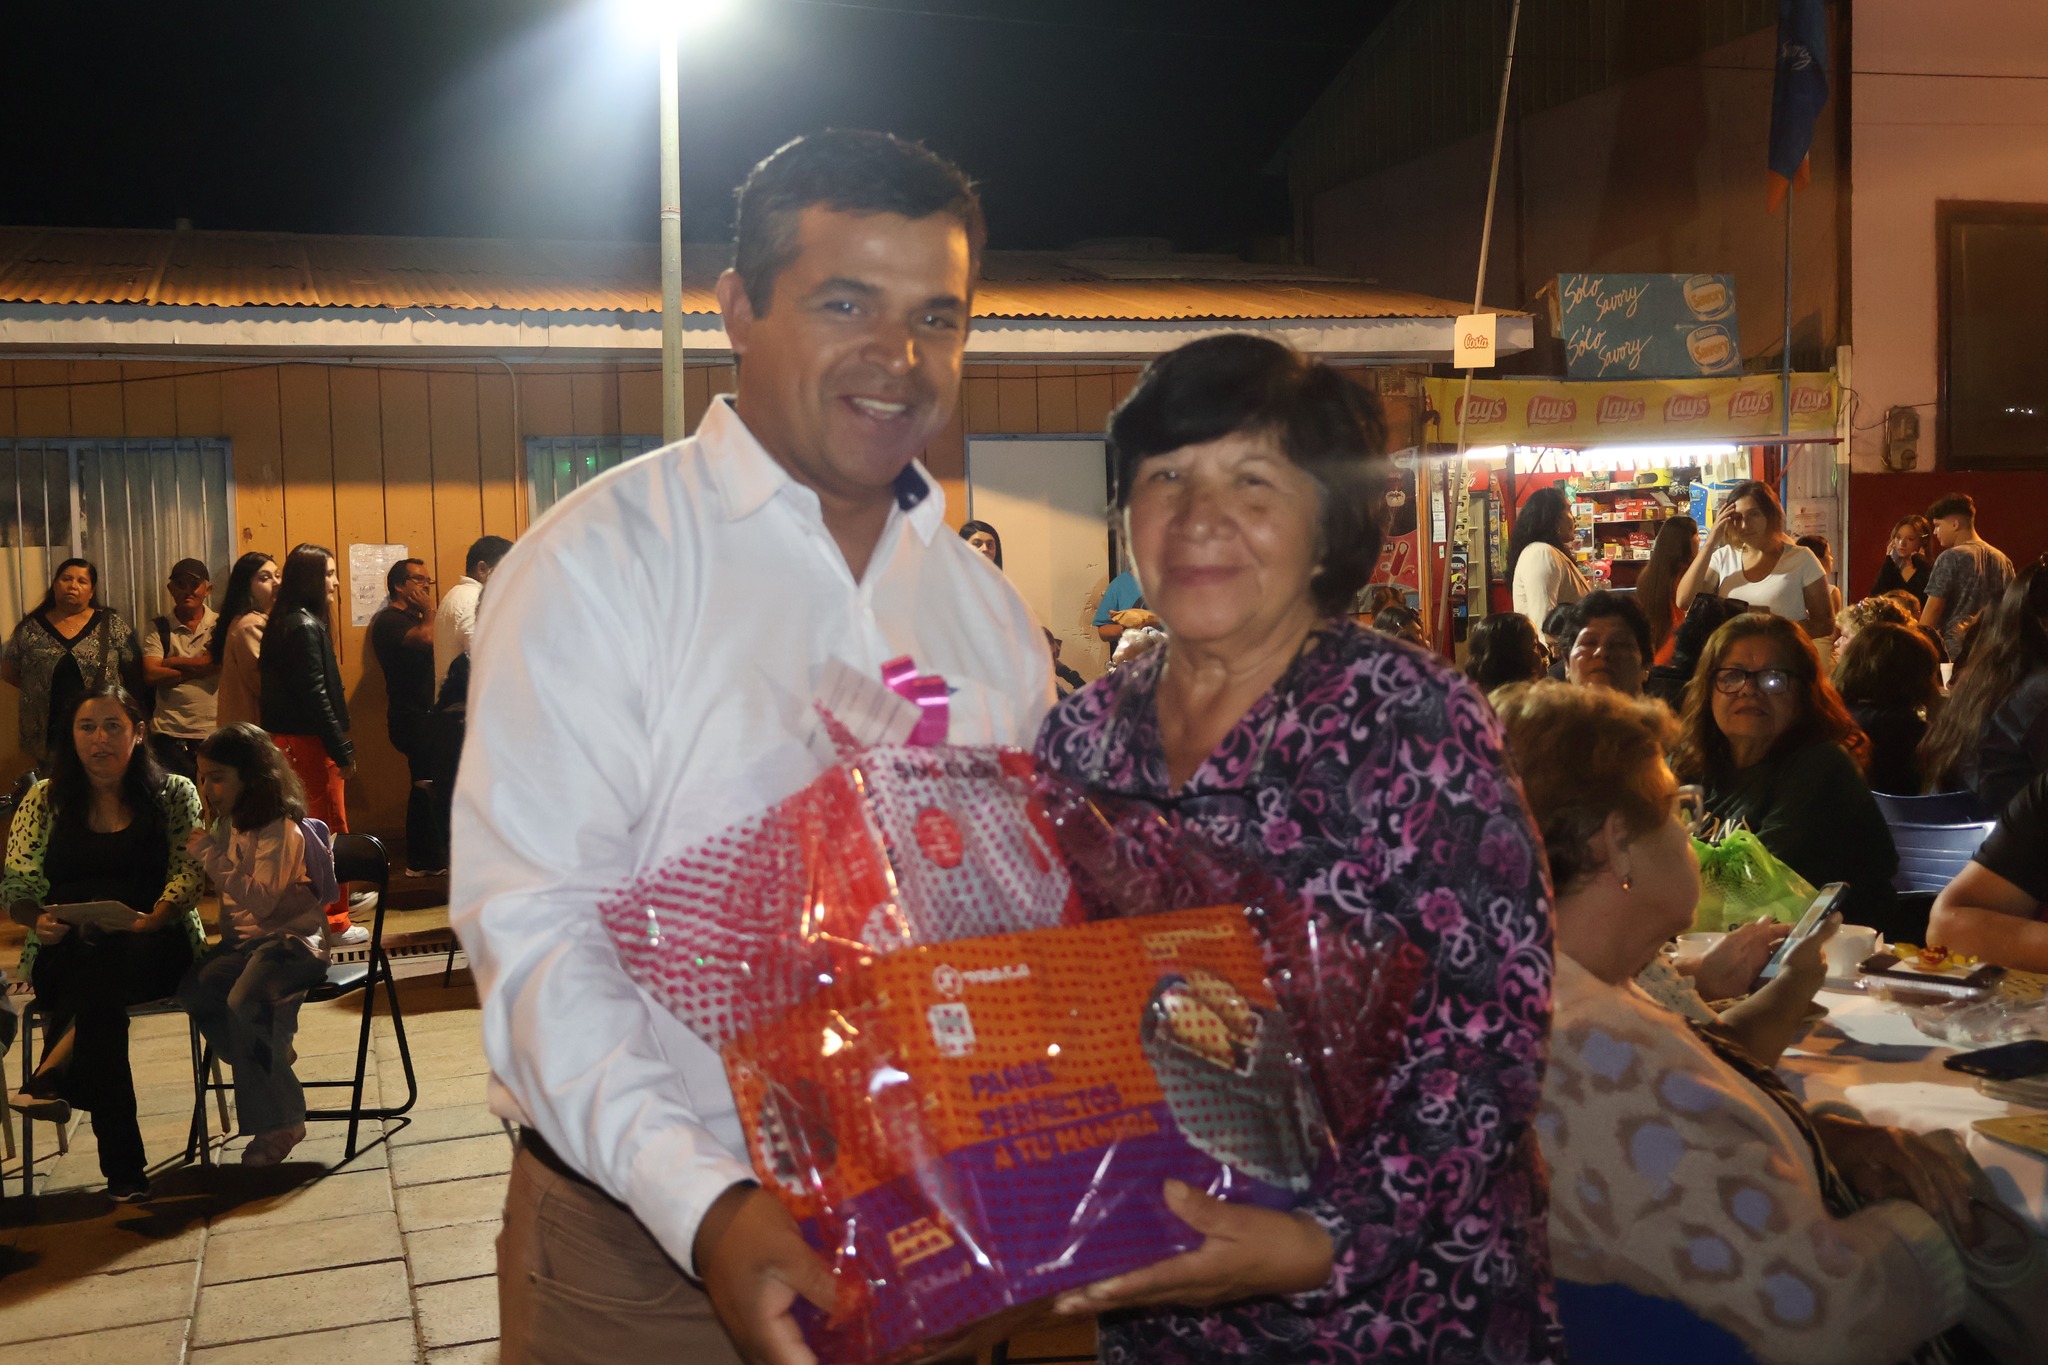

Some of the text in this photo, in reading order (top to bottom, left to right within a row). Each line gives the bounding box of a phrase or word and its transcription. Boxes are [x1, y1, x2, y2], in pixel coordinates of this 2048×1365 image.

[1564, 274, 1603, 314] Sólo
[1596, 283, 1649, 322] Savory
[1464, 333, 1489, 349] Costa
[1567, 325, 1607, 366] Sólo
[1598, 336, 1653, 378] Savory
[969, 1061, 1055, 1099] PANES
[979, 1083, 1122, 1134] PERFECTOS
[995, 1111, 1160, 1171] A TU MANERA
